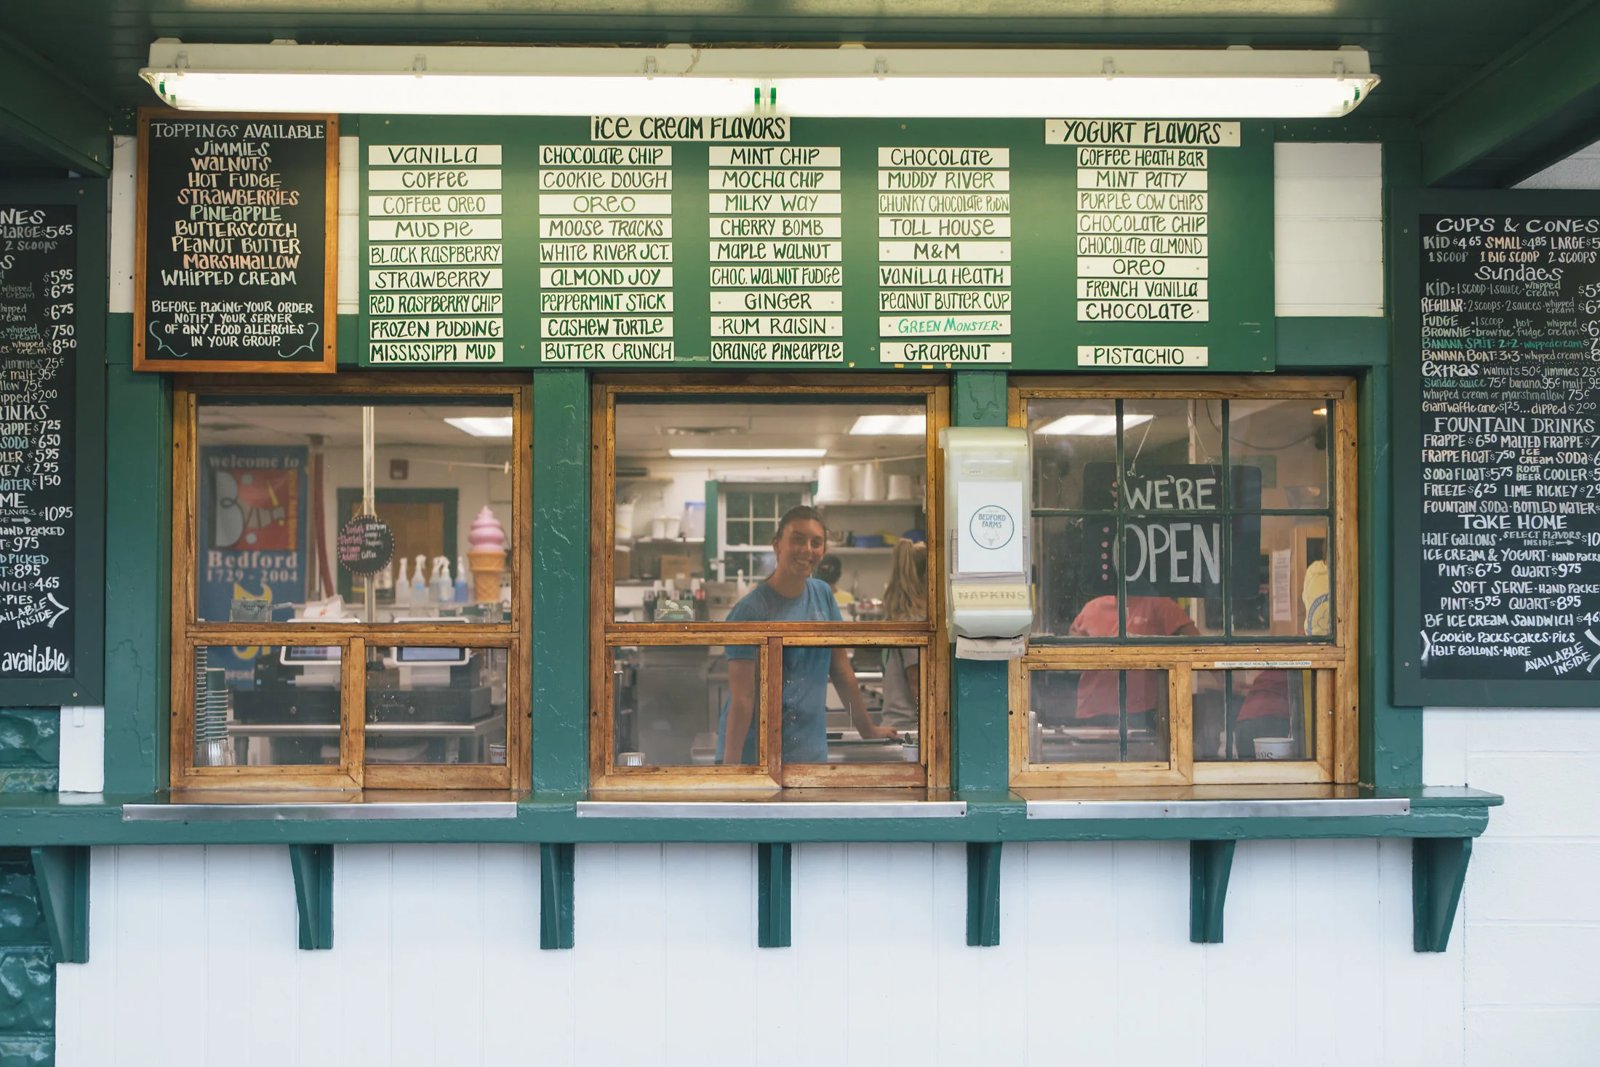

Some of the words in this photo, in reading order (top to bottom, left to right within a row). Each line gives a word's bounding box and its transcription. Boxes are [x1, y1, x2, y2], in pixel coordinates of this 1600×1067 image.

[244, 124, 324, 139] AVAILABLE
[1064, 121, 1137, 143] YOGURT
[629, 148, 663, 165] CHIP
[731, 148, 774, 164] MINT
[780, 148, 819, 165] CHIP
[188, 172, 221, 187] HOT
[230, 173, 281, 187] FUDGE
[611, 172, 667, 188] DOUGH
[790, 172, 824, 188] CHIP
[888, 172, 938, 188] MUDDY
[1096, 171, 1139, 187] MINT
[725, 195, 772, 211] MILKY
[1137, 194, 1165, 210] COW
[174, 220, 297, 239] BUTTERSCOTCH
[395, 222, 439, 238] MUD
[783, 220, 823, 236] BOMB
[890, 219, 931, 236] TOLL
[1172, 216, 1205, 232] CHIP
[1436, 218, 1495, 232] CUPS
[1504, 218, 1519, 232] &
[1526, 219, 1599, 233] CONES
[242, 238, 301, 254] BUTTER
[640, 244, 669, 260] JCT.
[914, 243, 960, 260] M&M
[1488, 252, 1506, 262] BIG
[1509, 251, 1539, 262] SCOOP
[628, 269, 660, 285] JOY
[1475, 264, 1563, 282] Sundaes
[152, 300, 197, 313] BEFORE
[244, 301, 274, 313] YOUR
[278, 302, 314, 313] ORDER
[472, 295, 501, 312] CHIP
[984, 292, 1009, 309] CUP
[175, 313, 214, 323] NOTIFY
[220, 313, 246, 325] YOUR
[250, 314, 293, 324] SERVER
[723, 318, 759, 334] RUM
[165, 324, 178, 334] OF
[214, 323, 241, 335] FOOD
[436, 321, 500, 337] PUDDING
[191, 336, 202, 347] IN
[207, 336, 239, 347] YOUR
[243, 335, 280, 347] GROUP.
[371, 343, 457, 361] MISSISSIPPI
[466, 344, 495, 359] MUD
[613, 343, 671, 360] CRUNCH
[1434, 417, 1525, 432] FOUNTAIN
[1532, 418, 1595, 433] DRINKS
[209, 456, 280, 468] welcome
[284, 456, 299, 468] to
[1124, 475, 1216, 510] WE'RE
[1424, 483, 1466, 496] FREEZE
[1505, 484, 1532, 497] LIME
[1537, 484, 1578, 497] RICKEY
[1518, 514, 1567, 530] HOME
[8, 554, 49, 566] PICKED
[208, 551, 297, 569] Bedford
[1113, 523, 1220, 584] OPEN
[207, 570, 244, 582] 1729
[261, 570, 297, 582] 2004
[1452, 580, 1487, 594] SOFT
[1491, 581, 1532, 594] SERVE
[17, 607, 55, 629] INSIDE
[1447, 615, 1466, 627] ICE
[2, 645, 69, 673] available
[1523, 640, 1585, 673] AVAILABLE
[1552, 649, 1593, 675] INSIDE
